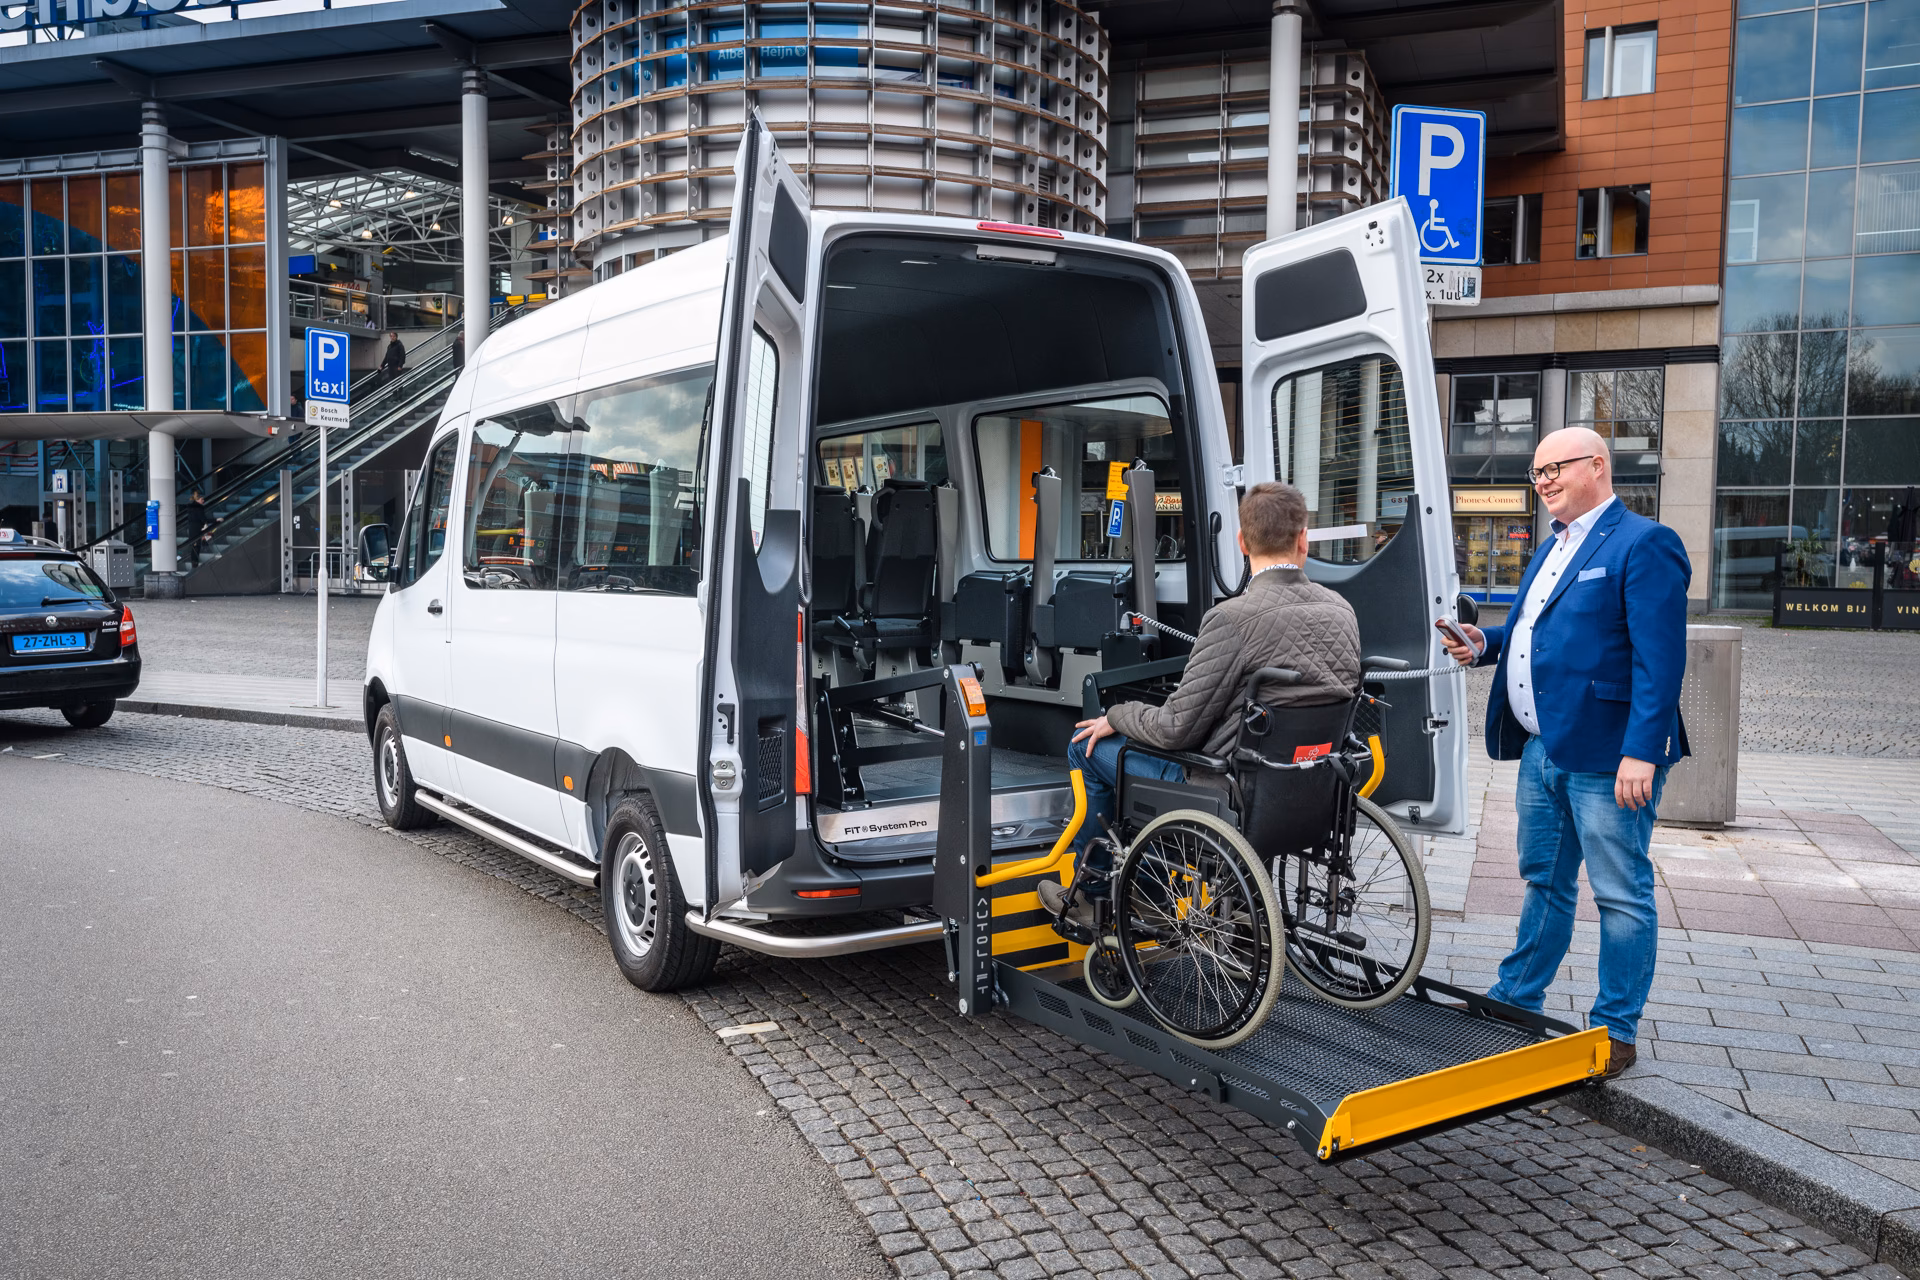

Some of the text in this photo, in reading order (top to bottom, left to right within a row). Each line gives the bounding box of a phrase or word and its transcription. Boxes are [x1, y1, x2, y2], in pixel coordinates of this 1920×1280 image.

[1418, 122, 1465, 196] P
[1426, 269, 1445, 283] 2x
[318, 336, 340, 371] P
[313, 378, 345, 396] taxi
[320, 406, 338, 414] Bosch
[320, 414, 349, 424] Keurmerk
[1785, 603, 1867, 613] WELKOM BIJ
[23, 635, 77, 648] 27-ZHL-3
[869, 822, 908, 833] System
[909, 820, 928, 828] Pro
[976, 897, 989, 994] AUTOLIFT
